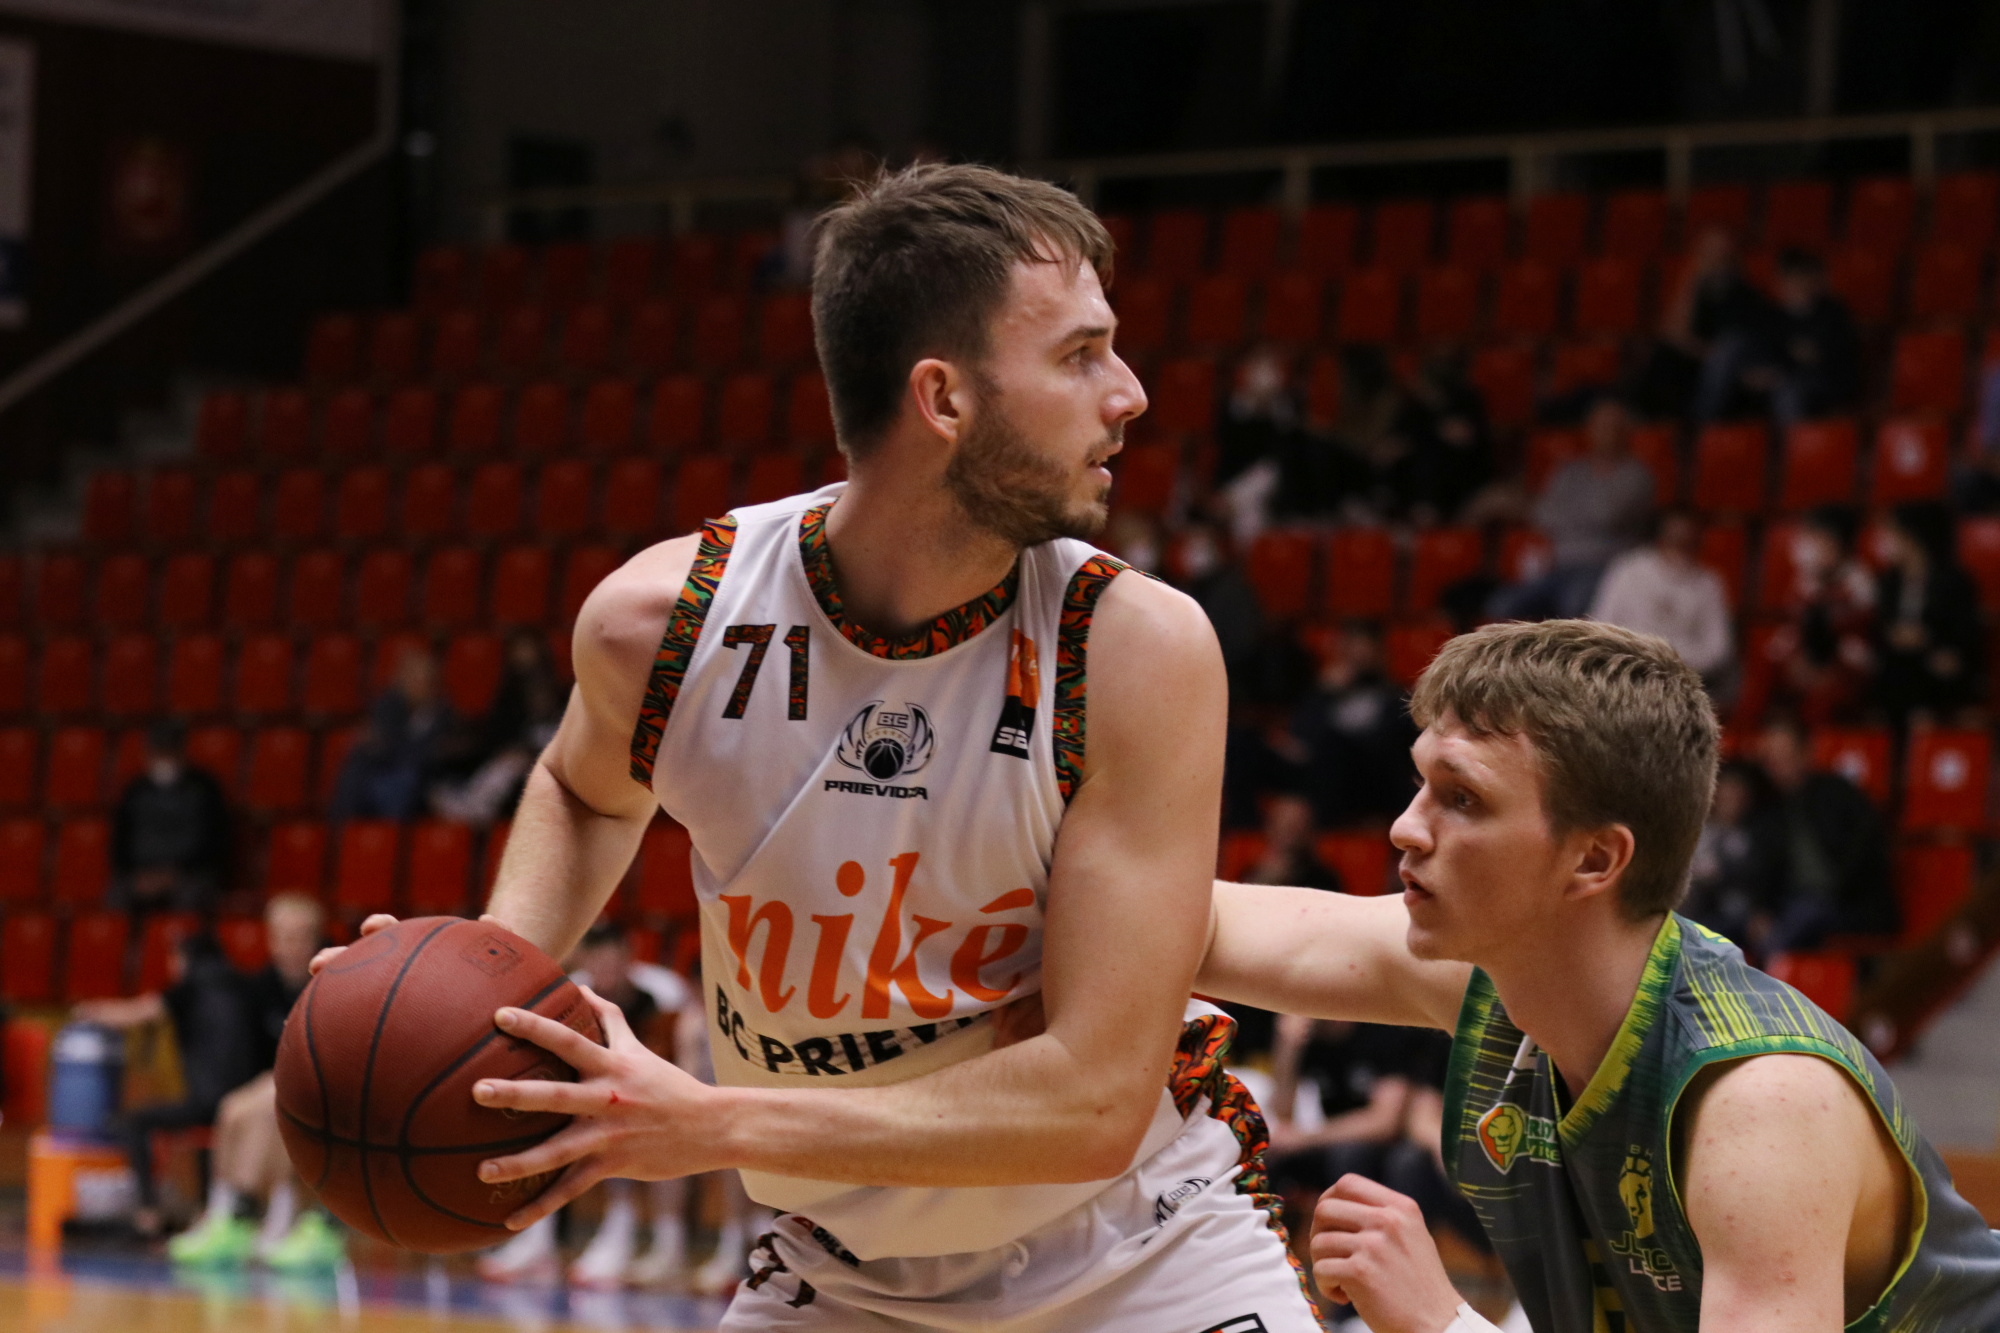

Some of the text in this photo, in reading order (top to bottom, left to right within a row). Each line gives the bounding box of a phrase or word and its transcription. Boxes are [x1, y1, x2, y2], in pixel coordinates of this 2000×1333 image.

[721, 623, 810, 720] 71
[877, 711, 909, 729] BC
[996, 725, 1029, 750] SB
[719, 851, 1036, 1019] niké
[717, 983, 749, 1061] BC
